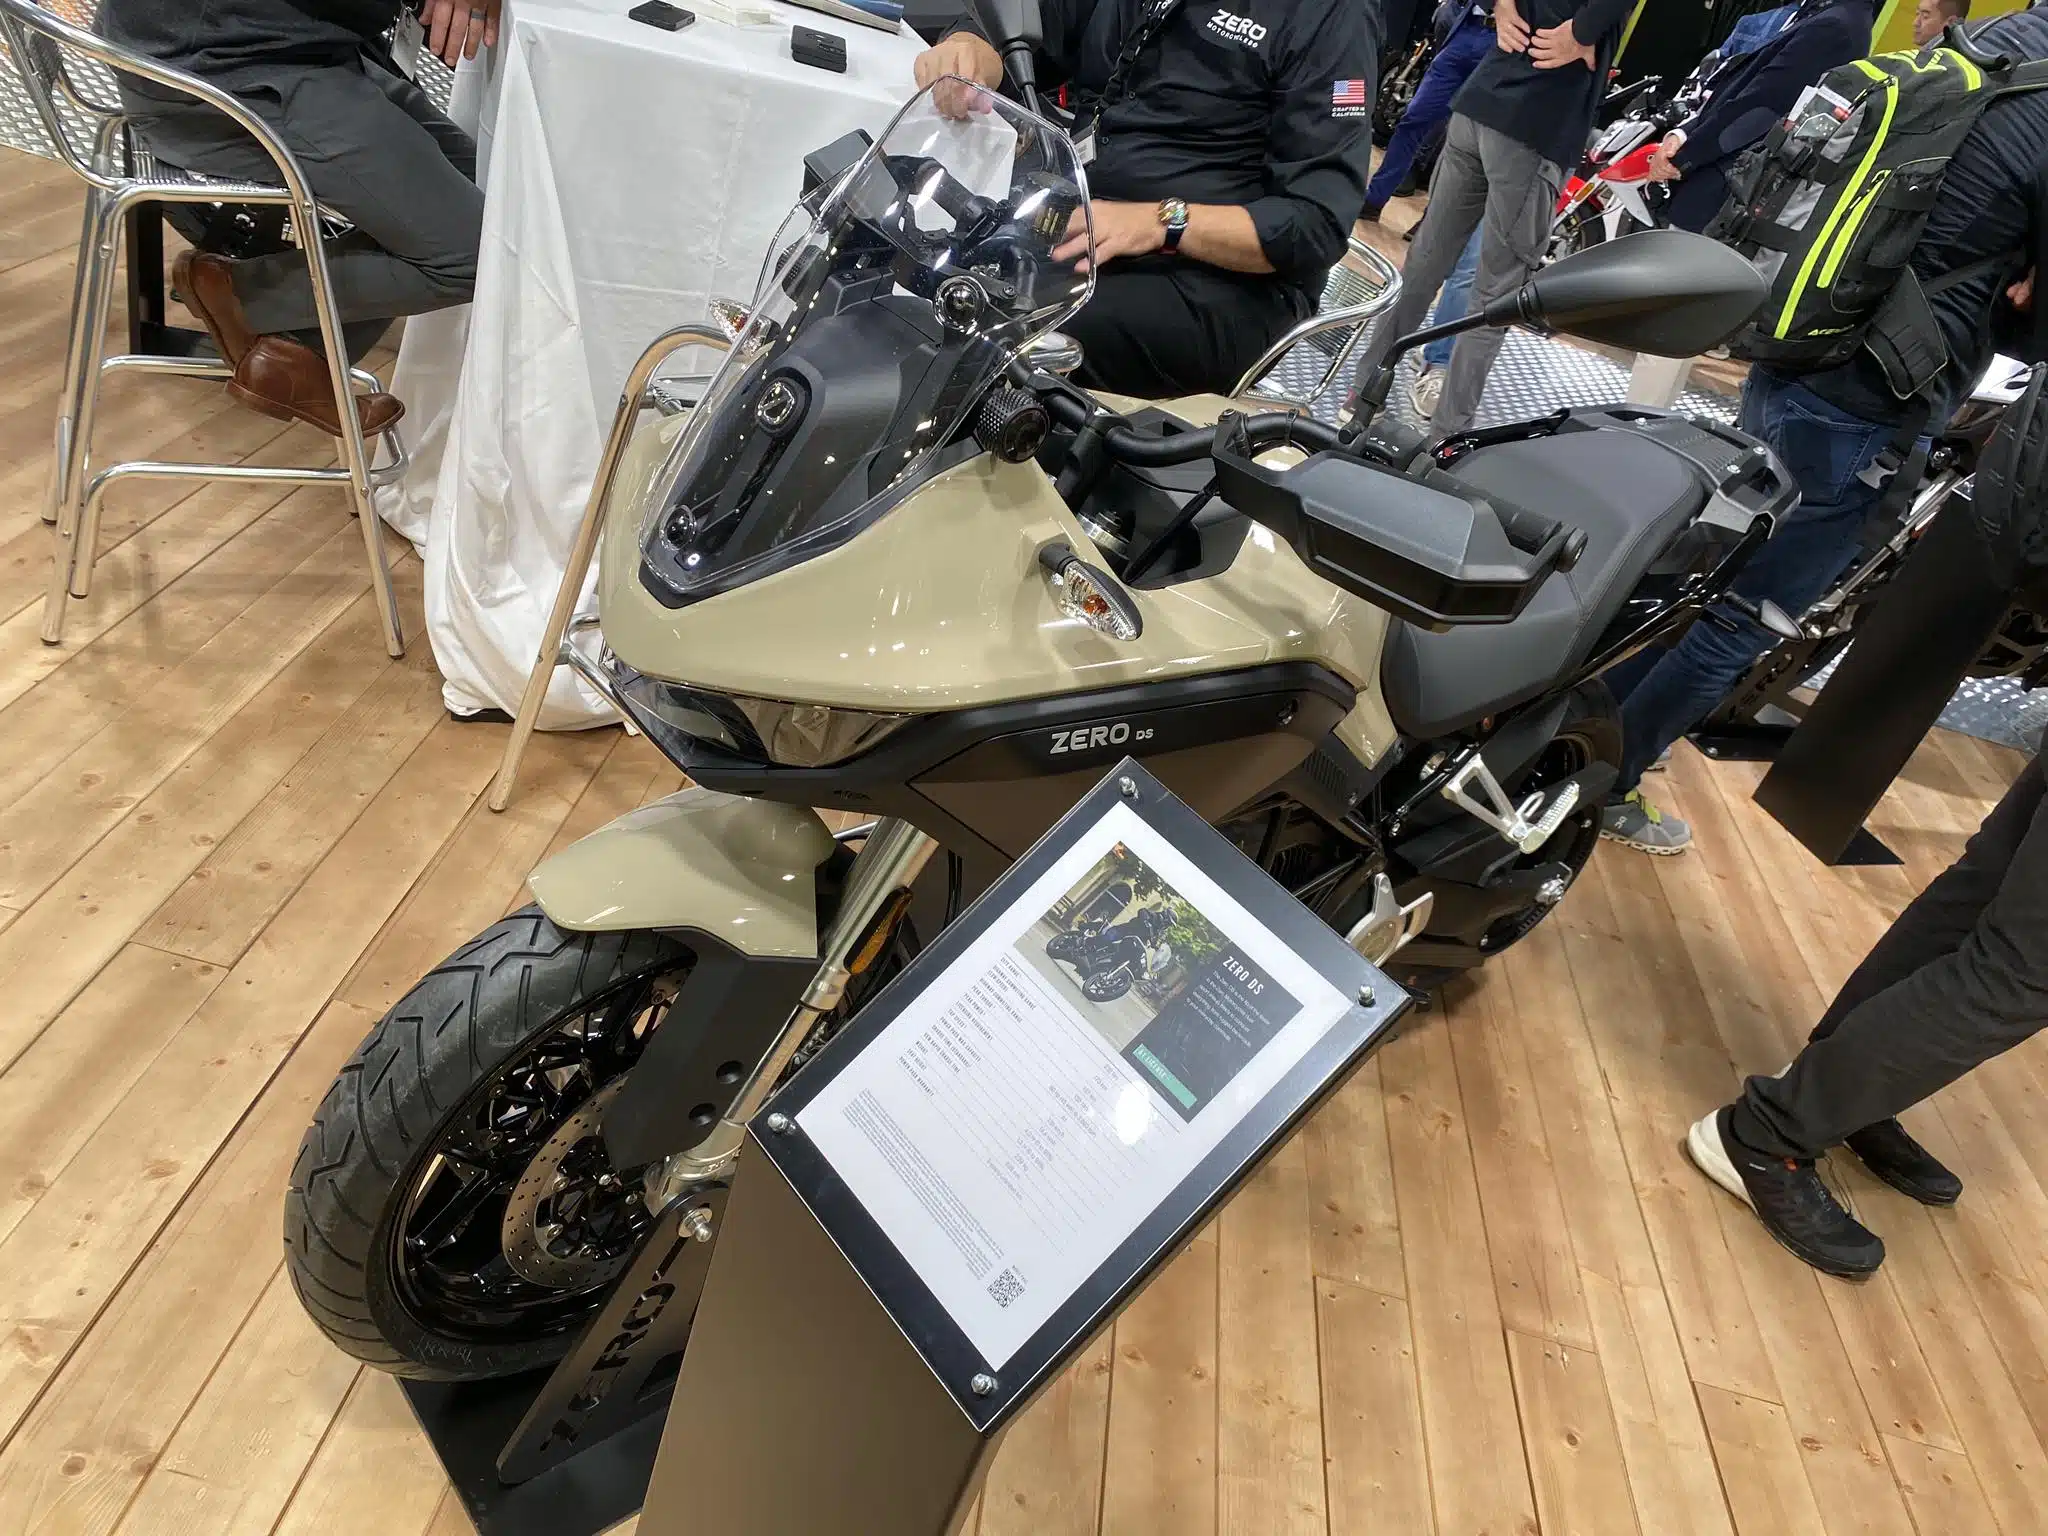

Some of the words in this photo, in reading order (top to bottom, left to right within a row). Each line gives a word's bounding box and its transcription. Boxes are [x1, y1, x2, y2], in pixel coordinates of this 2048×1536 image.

[1211, 8, 1267, 42] ZERO
[1050, 723, 1130, 755] ZERO
[1135, 728, 1154, 741] DS
[1223, 956, 1250, 981] ZERO
[1247, 978, 1264, 995] DS
